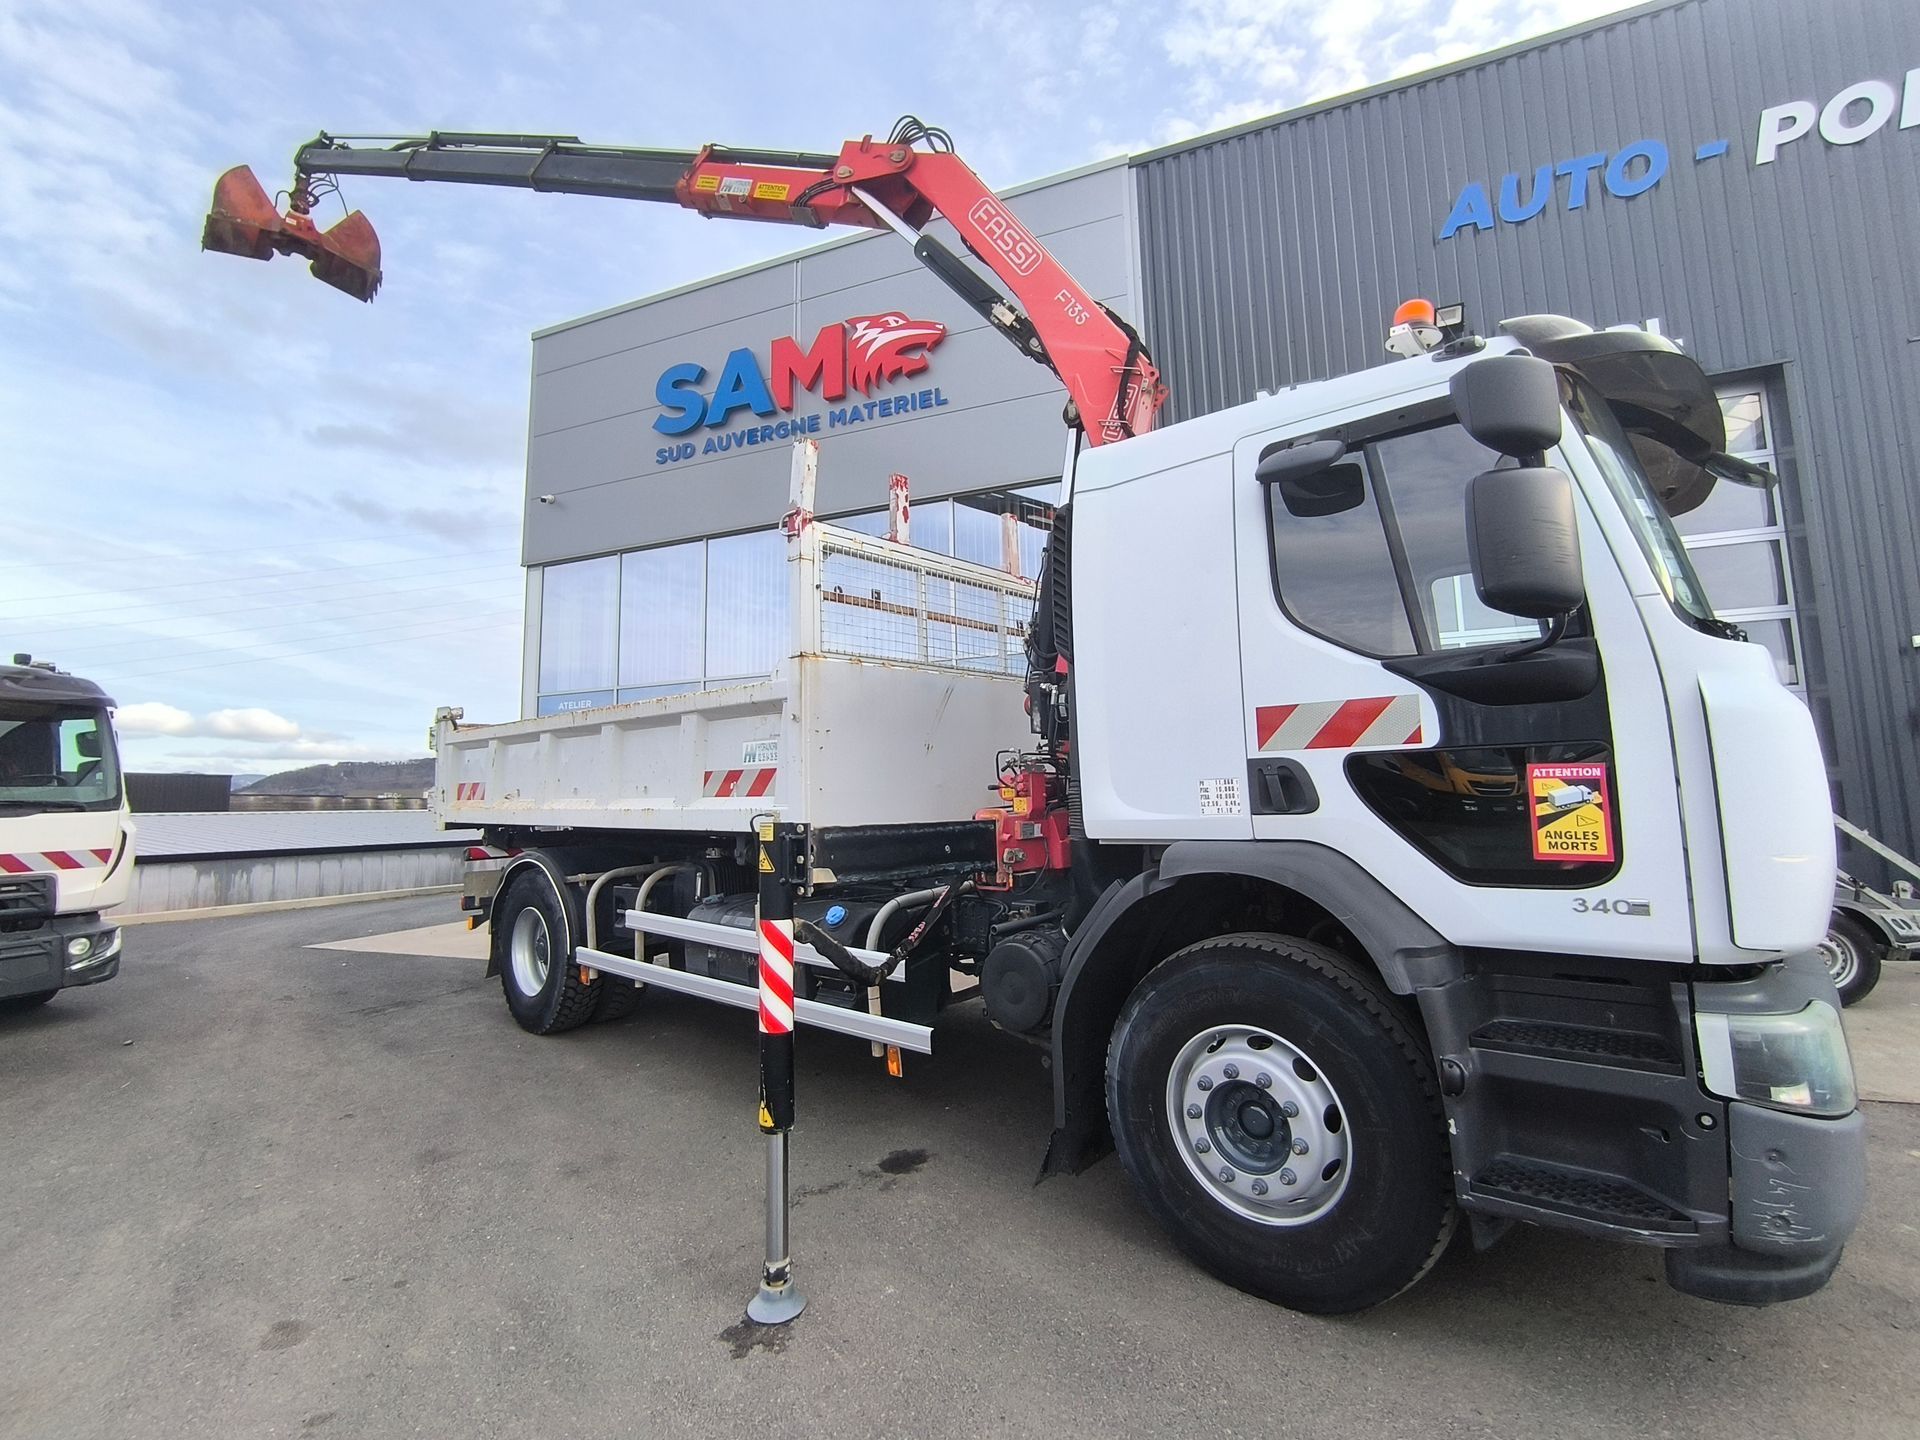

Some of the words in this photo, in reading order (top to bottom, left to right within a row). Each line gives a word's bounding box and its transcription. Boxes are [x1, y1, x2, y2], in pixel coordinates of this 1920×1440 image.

[1439, 139, 1669, 239] AUTO
[974, 203, 1037, 270] FASSI
[1054, 288, 1091, 326] F135
[652, 322, 848, 437] SAM
[655, 442, 696, 465] SUD
[702, 413, 822, 455] AUVERGNE
[828, 387, 949, 429] MATERIEL
[558, 700, 592, 710] ATELIER
[1532, 767, 1601, 777] ATTENTION
[1544, 831, 1600, 840] ANGLES
[1548, 841, 1598, 851] MORTS
[1572, 897, 1632, 915] 340
